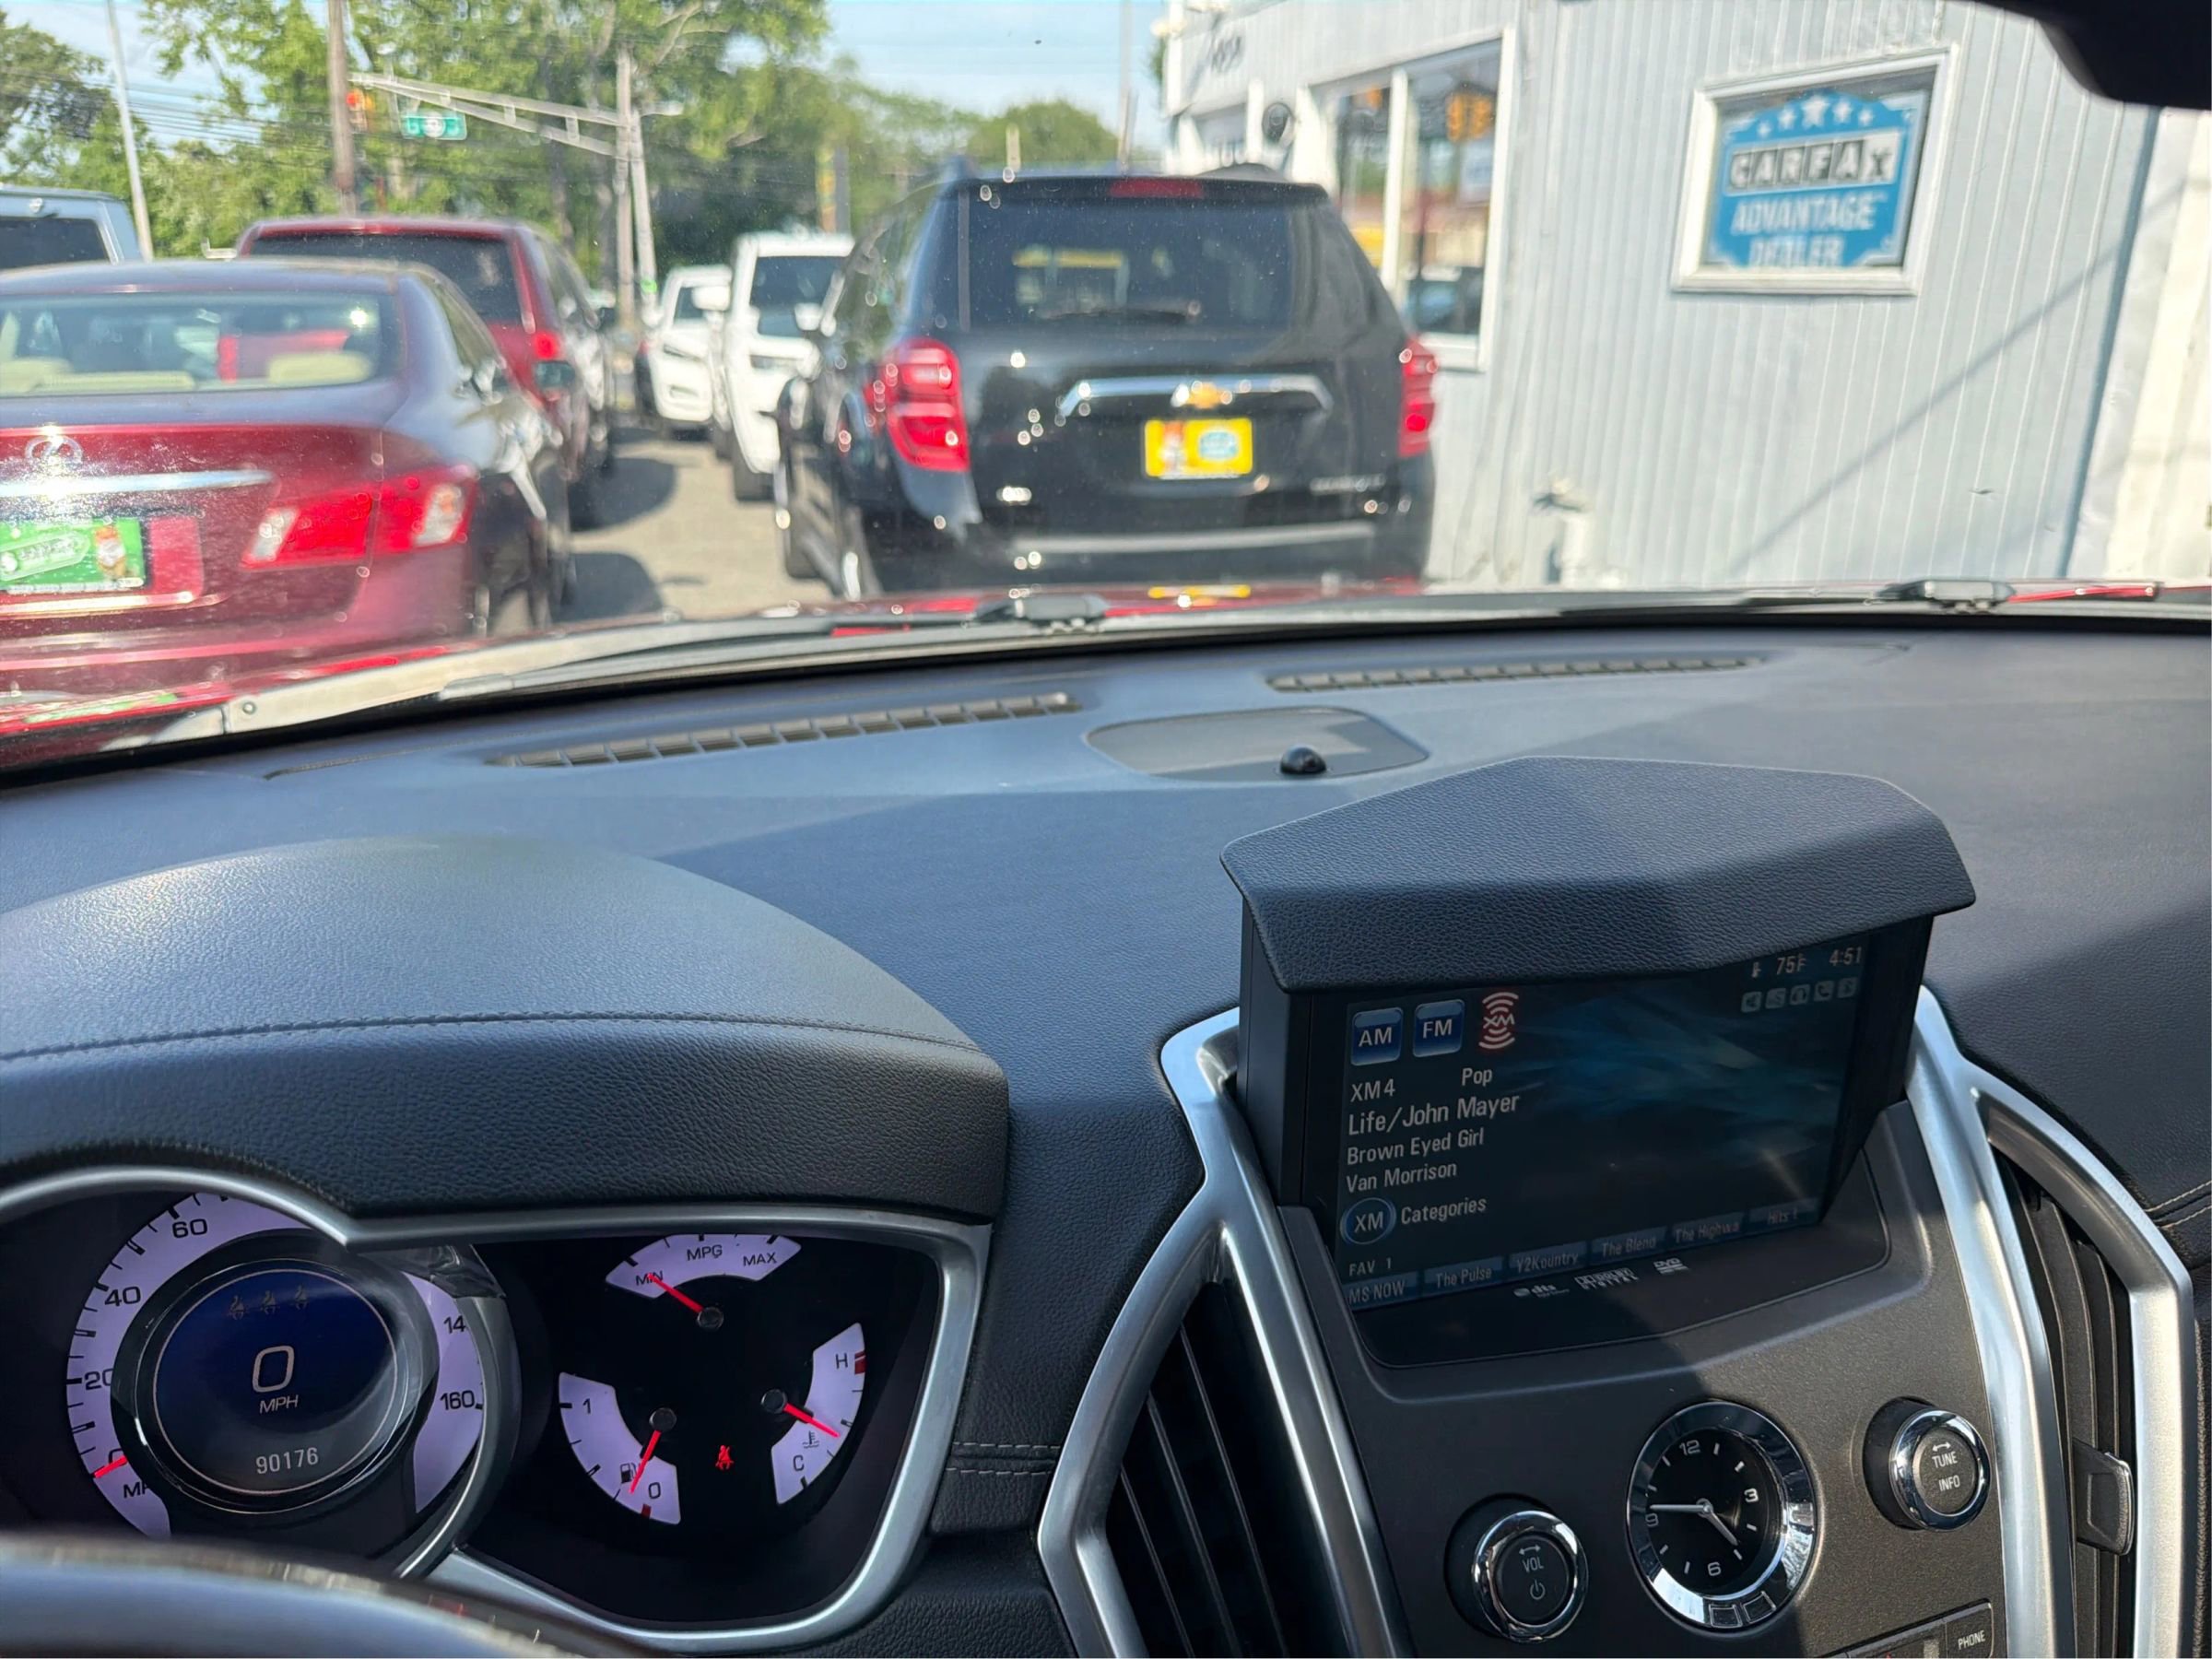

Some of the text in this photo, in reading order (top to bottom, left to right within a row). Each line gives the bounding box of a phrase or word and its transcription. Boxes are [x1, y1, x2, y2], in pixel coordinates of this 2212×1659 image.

[1730, 141, 1894, 188] CARFAX
[1730, 193, 1877, 236] ADVANTAGE
[1829, 946, 1863, 967] 4:51
[1358, 1026, 1394, 1048] AM
[1422, 1018, 1453, 1039] FM
[1461, 1067, 1492, 1088] Pop
[1348, 1094, 1520, 1135] Life/John Mayer
[1347, 1126, 1484, 1165] Brown Eyed Girl
[1347, 1162, 1457, 1194] Van Morrison
[1354, 1196, 1487, 1234] XM Categories
[172, 1218, 207, 1239] 60
[1674, 1228, 1695, 1243] The
[687, 1244, 723, 1261] MPG
[1601, 1236, 1657, 1258] The Blend
[743, 1252, 778, 1266] MAX
[1348, 1256, 1393, 1277] FAV 1
[635, 1270, 664, 1286] MIN
[1435, 1266, 1492, 1288] The Pulse
[104, 1286, 141, 1306] 40
[1373, 1279, 1406, 1300] NOW
[443, 1315, 468, 1335] 14
[252, 1345, 295, 1393] 0
[835, 1354, 849, 1370] H
[259, 1394, 300, 1415] MPH
[440, 1390, 475, 1411] 160
[582, 1399, 592, 1414] 1
[1679, 1439, 1700, 1456] 12
[255, 1447, 319, 1475] 90176
[793, 1454, 805, 1472] C
[1932, 1451, 1959, 1468] TUNE
[1938, 1475, 1960, 1491] INFO
[1744, 1488, 1759, 1503] 3
[1644, 1512, 1659, 1528] 9
[1522, 1556, 1545, 1573] VOL
[1707, 1561, 1722, 1577] 6
[1958, 1630, 1986, 1650] PHONE
